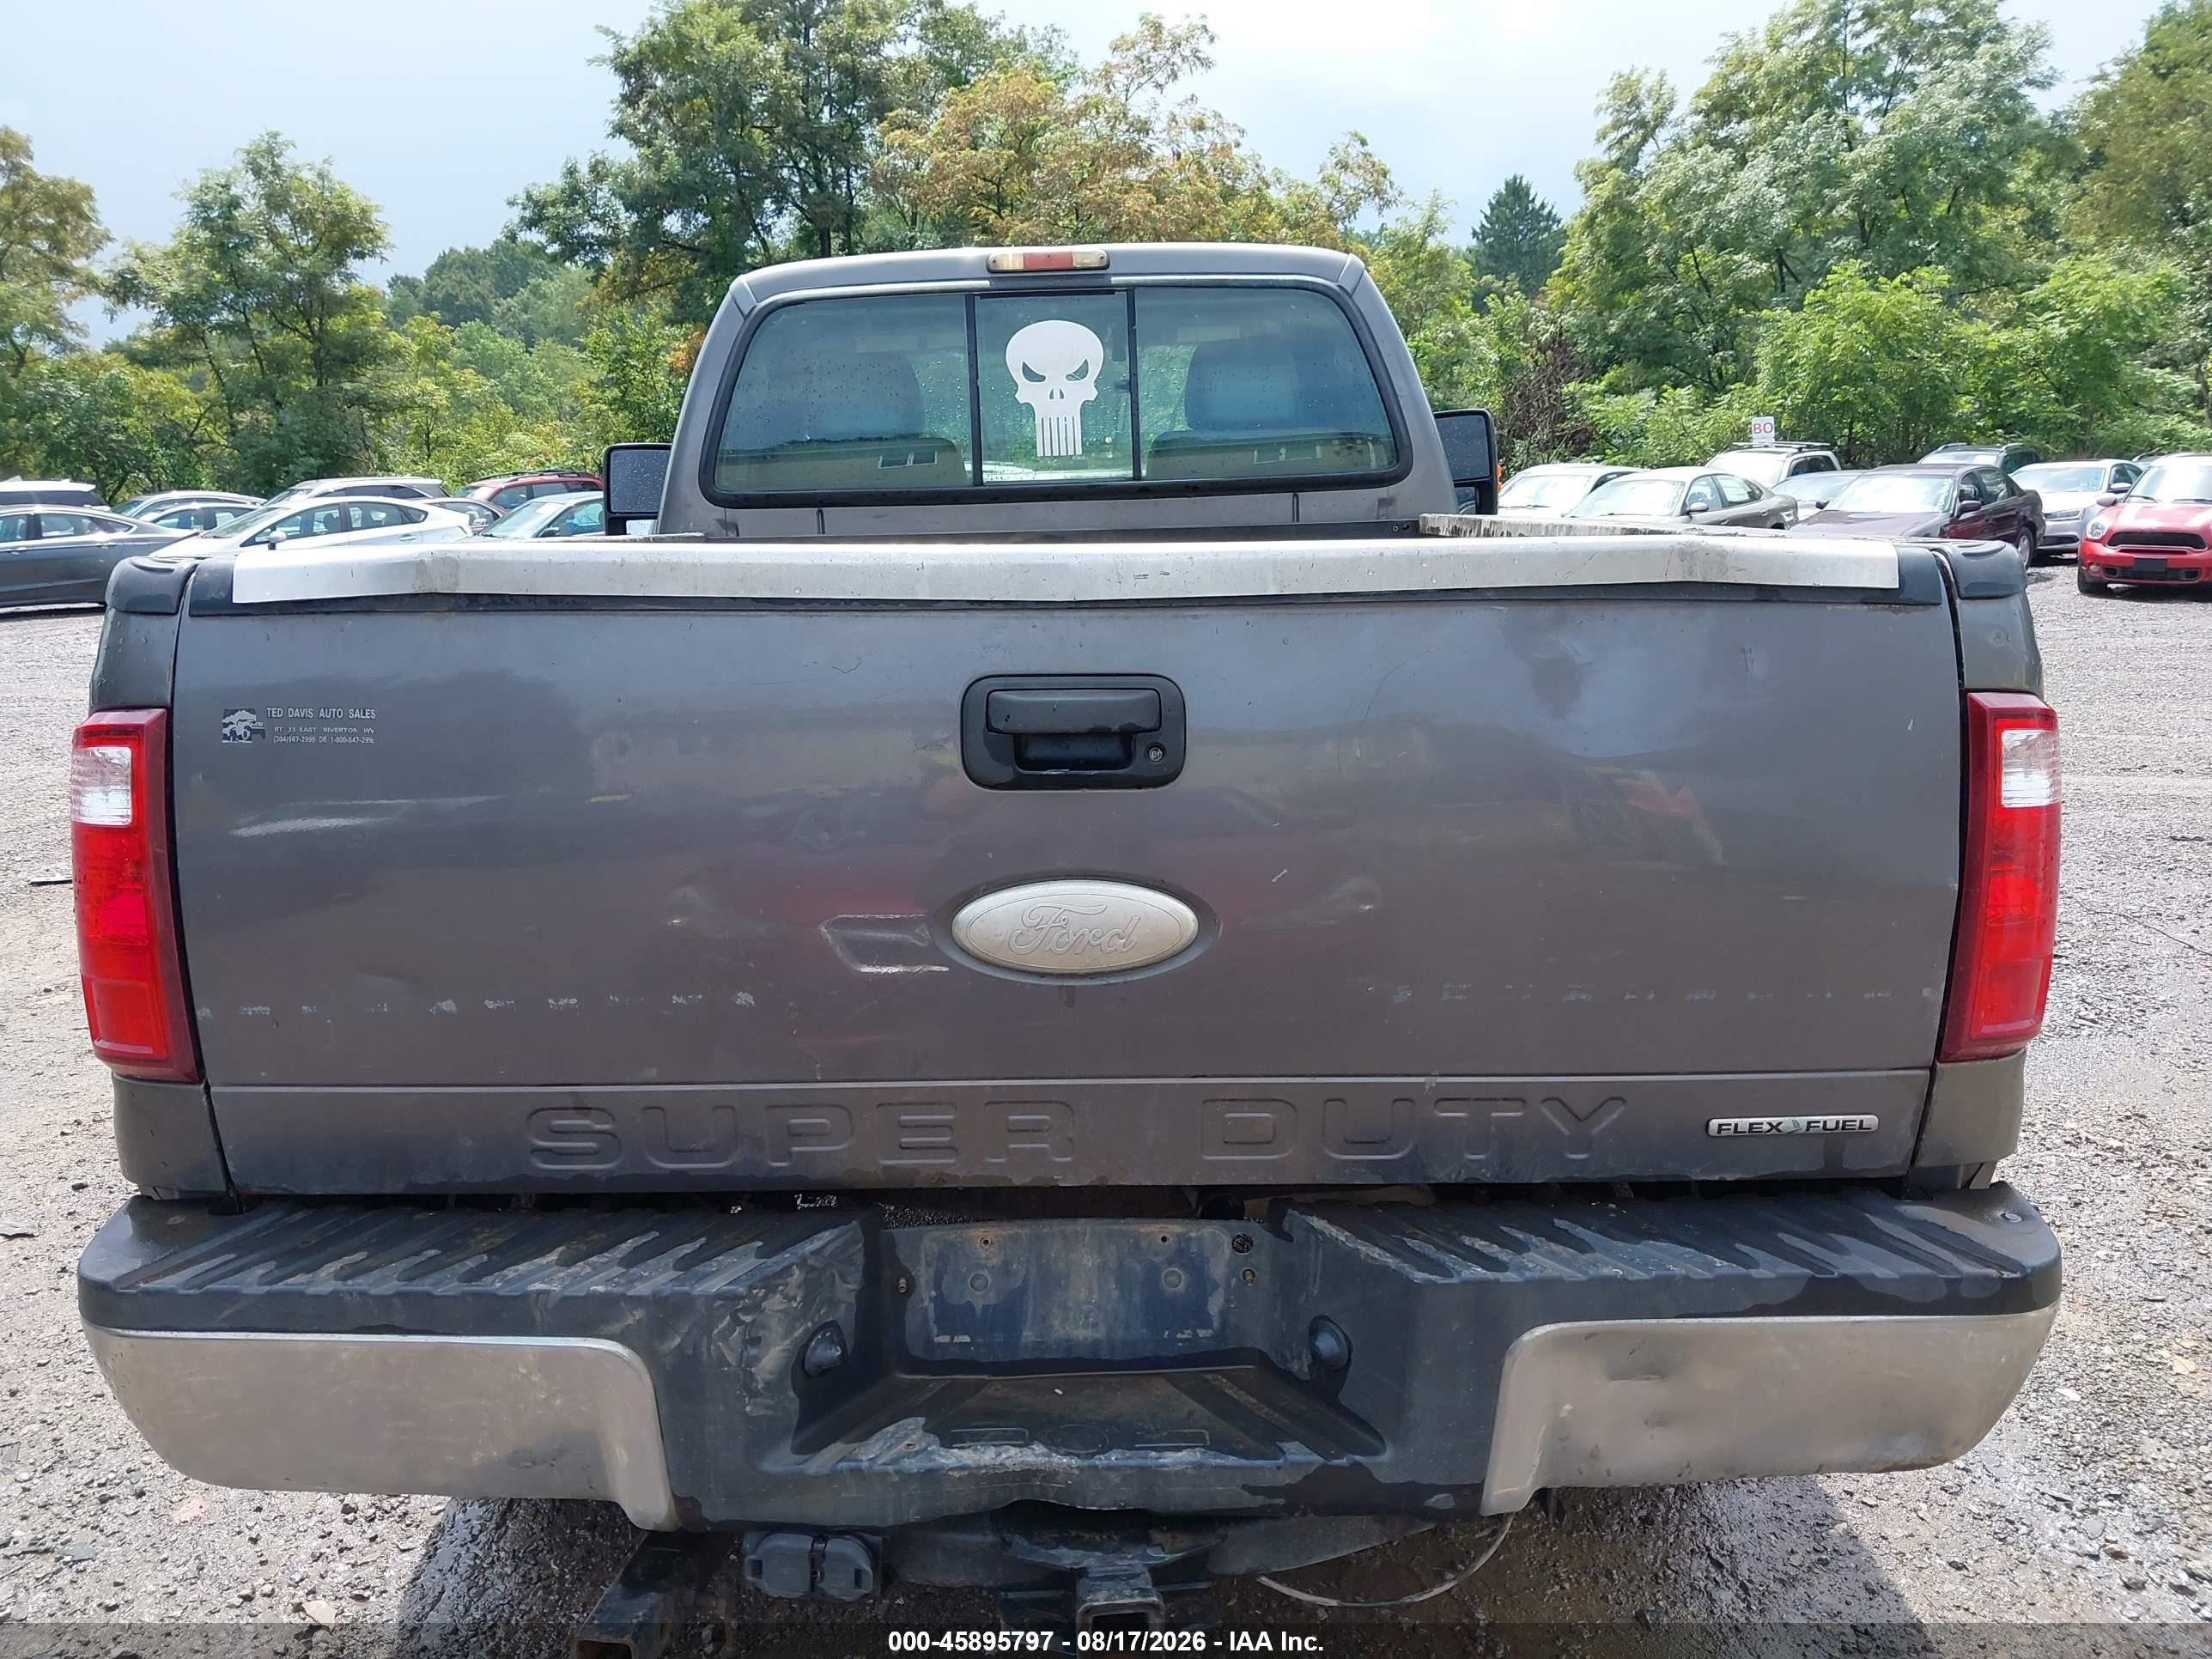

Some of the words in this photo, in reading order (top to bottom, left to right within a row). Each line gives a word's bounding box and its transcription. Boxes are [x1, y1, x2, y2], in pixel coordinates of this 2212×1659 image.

[1753, 422, 1773, 434] BO
[266, 707, 283, 718] TED
[288, 707, 314, 719] DAVIS
[319, 708, 343, 719] AUTO
[349, 708, 376, 720] SALES
[1008, 902, 1141, 956] Ford
[526, 1100, 1077, 1170] SUPER
[1201, 1097, 1627, 1163] DUTY
[1717, 1121, 1784, 1134] FLEX
[1805, 1119, 1872, 1133] FUEL
